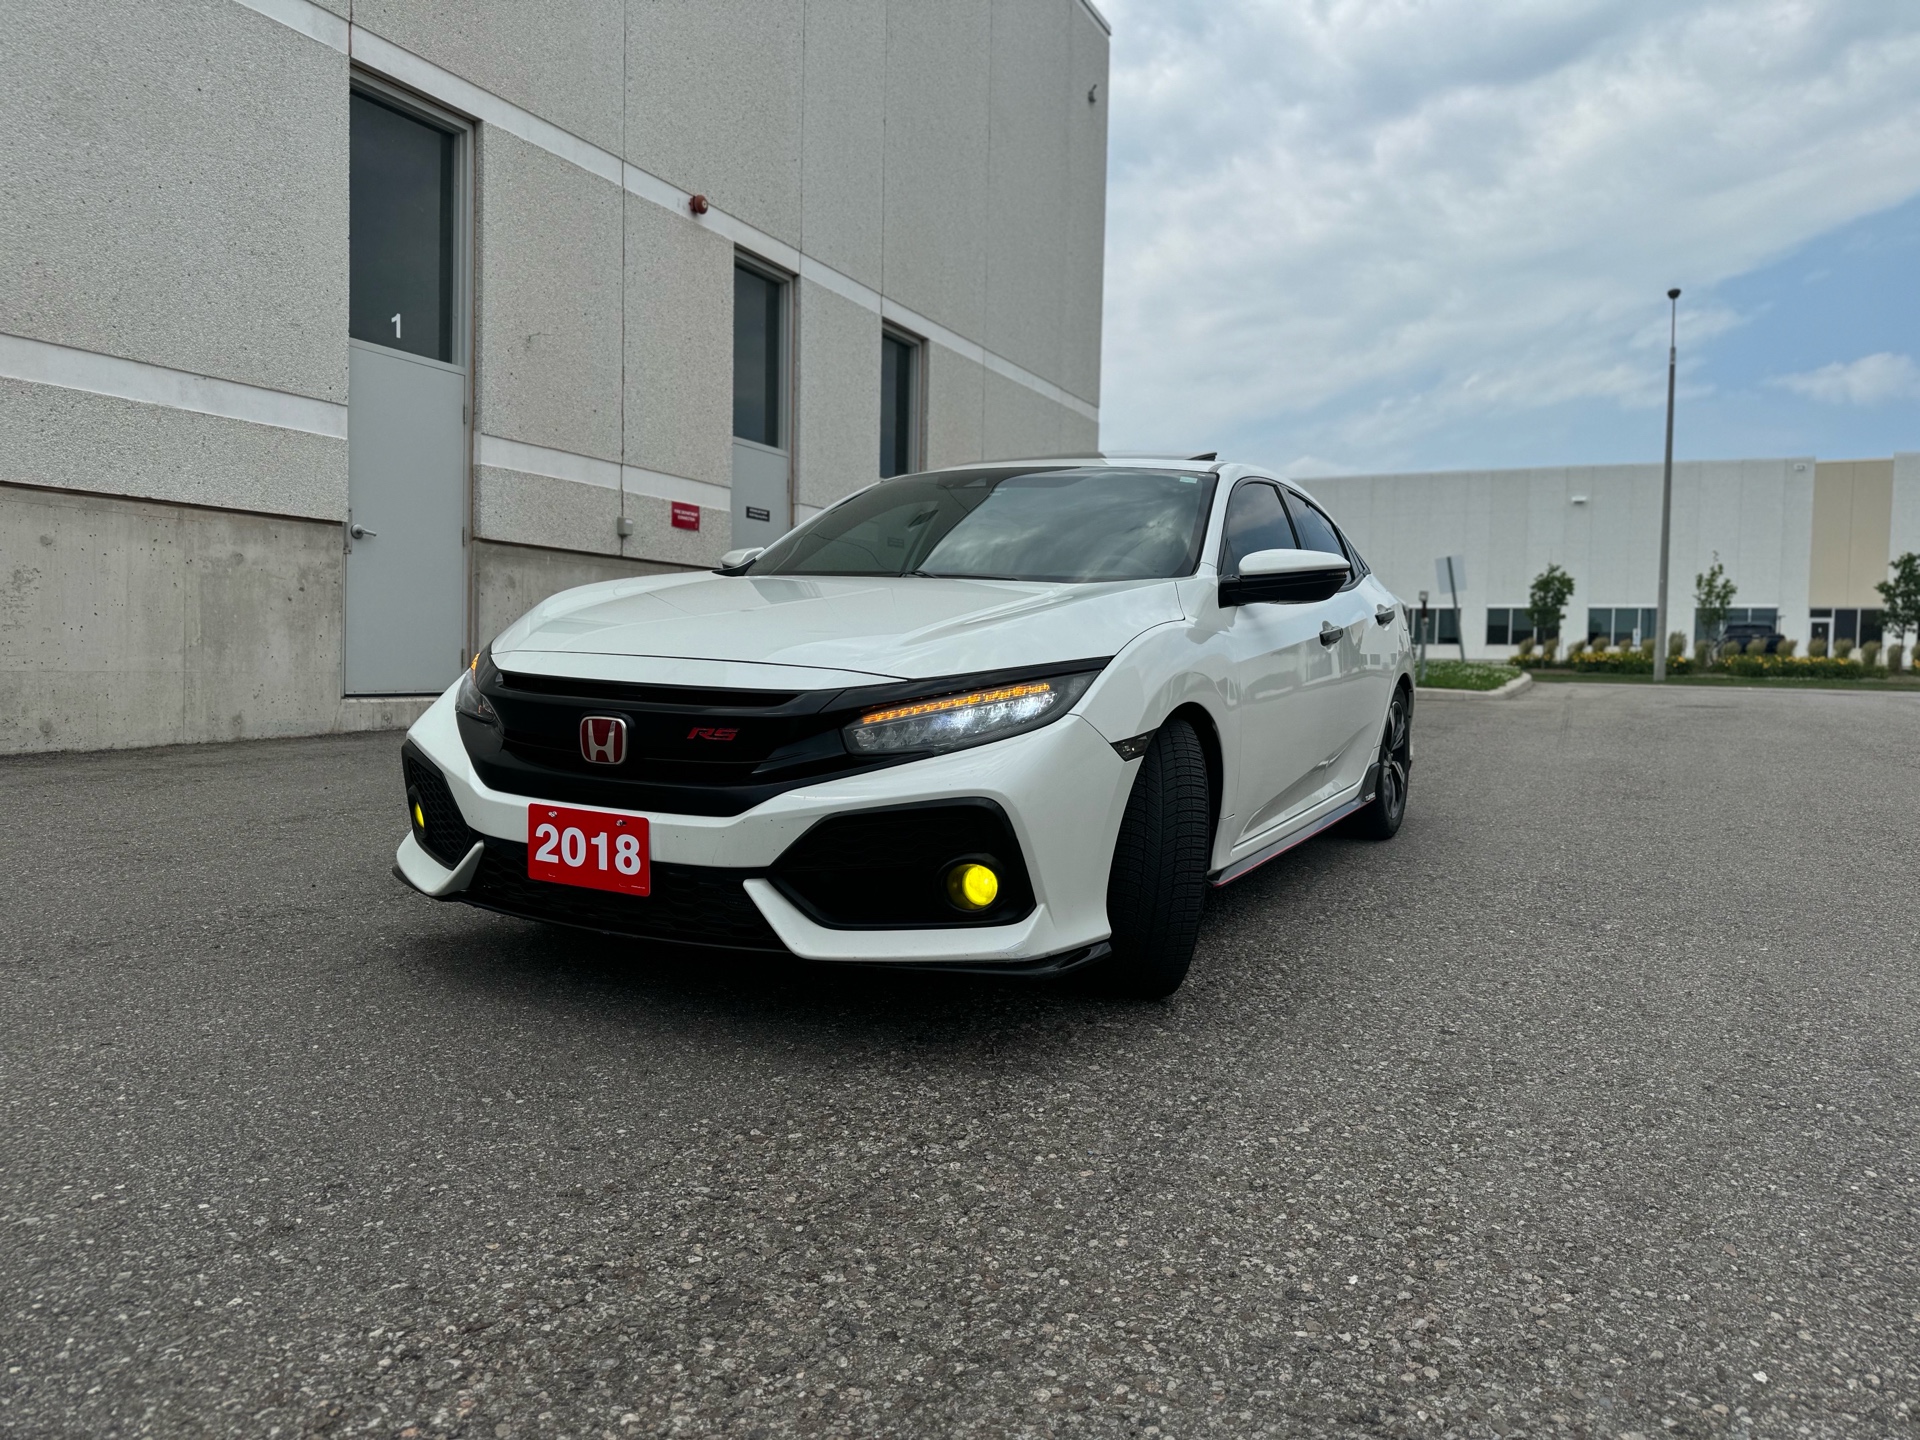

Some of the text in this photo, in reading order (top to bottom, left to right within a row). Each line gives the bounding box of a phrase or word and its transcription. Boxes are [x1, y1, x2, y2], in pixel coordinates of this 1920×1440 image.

[391, 312, 401, 339] 1
[686, 726, 740, 741] RS
[535, 823, 641, 876] 2018
